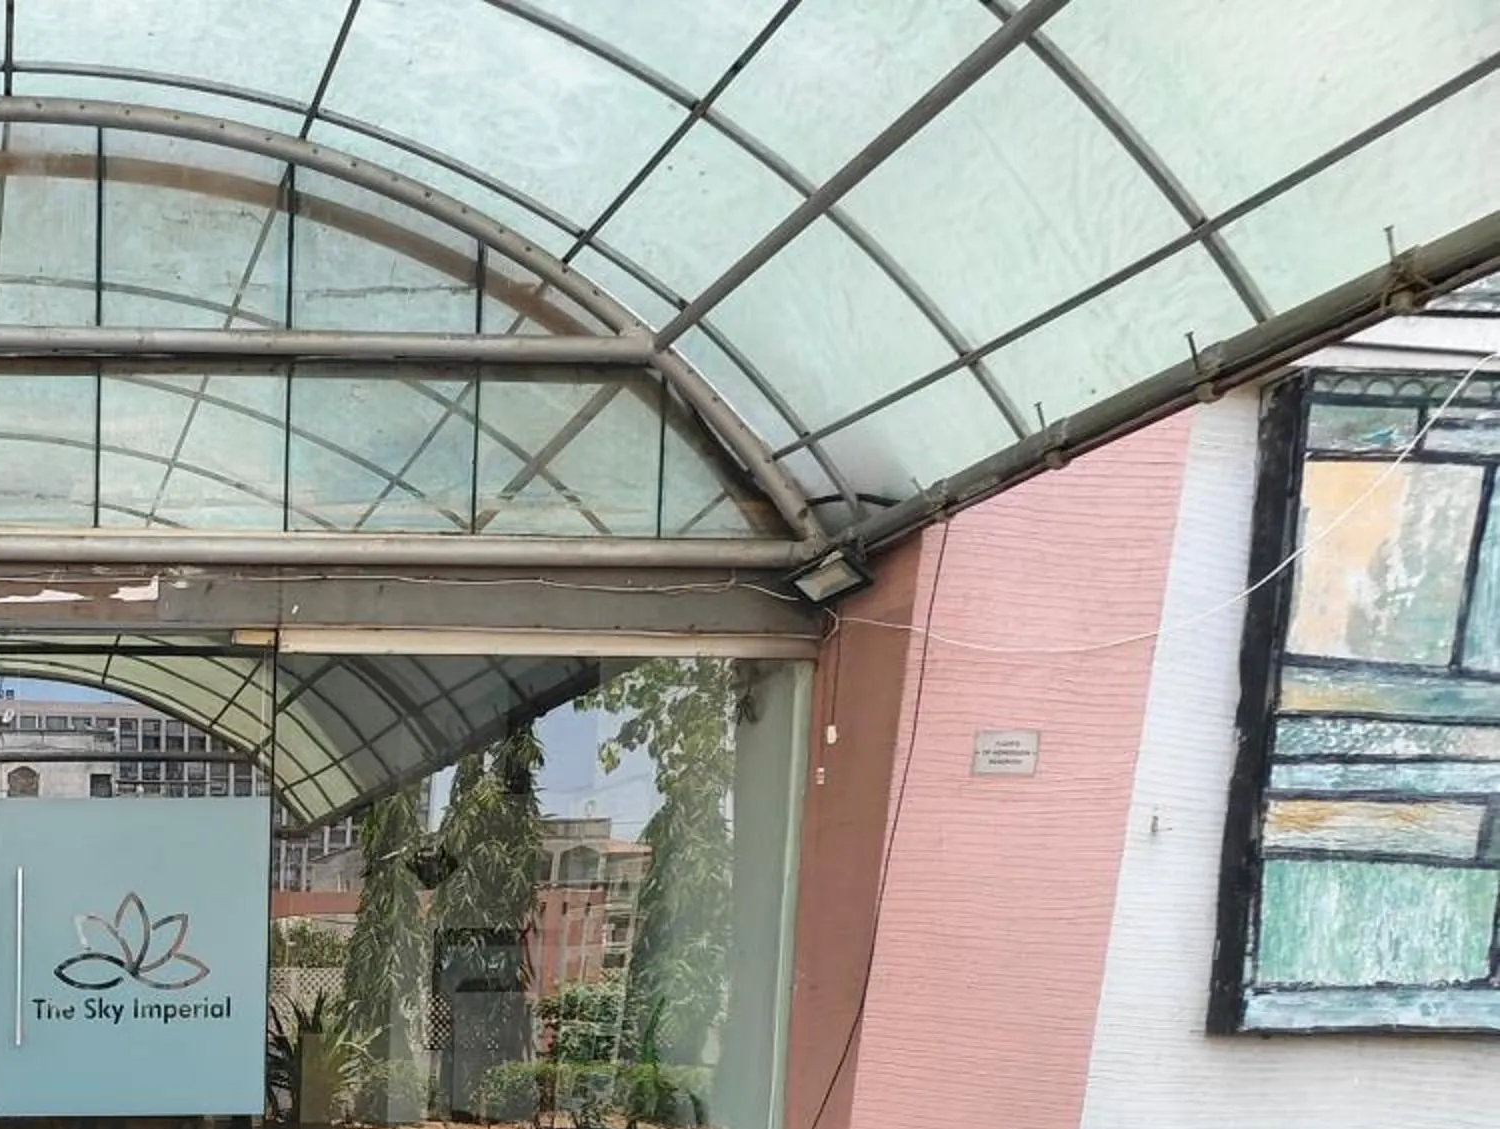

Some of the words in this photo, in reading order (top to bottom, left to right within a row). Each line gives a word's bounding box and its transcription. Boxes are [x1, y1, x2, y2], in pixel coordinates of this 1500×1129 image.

[32, 997, 76, 1020] The
[83, 997, 125, 1025] Sky
[133, 995, 232, 1025] Imperial
